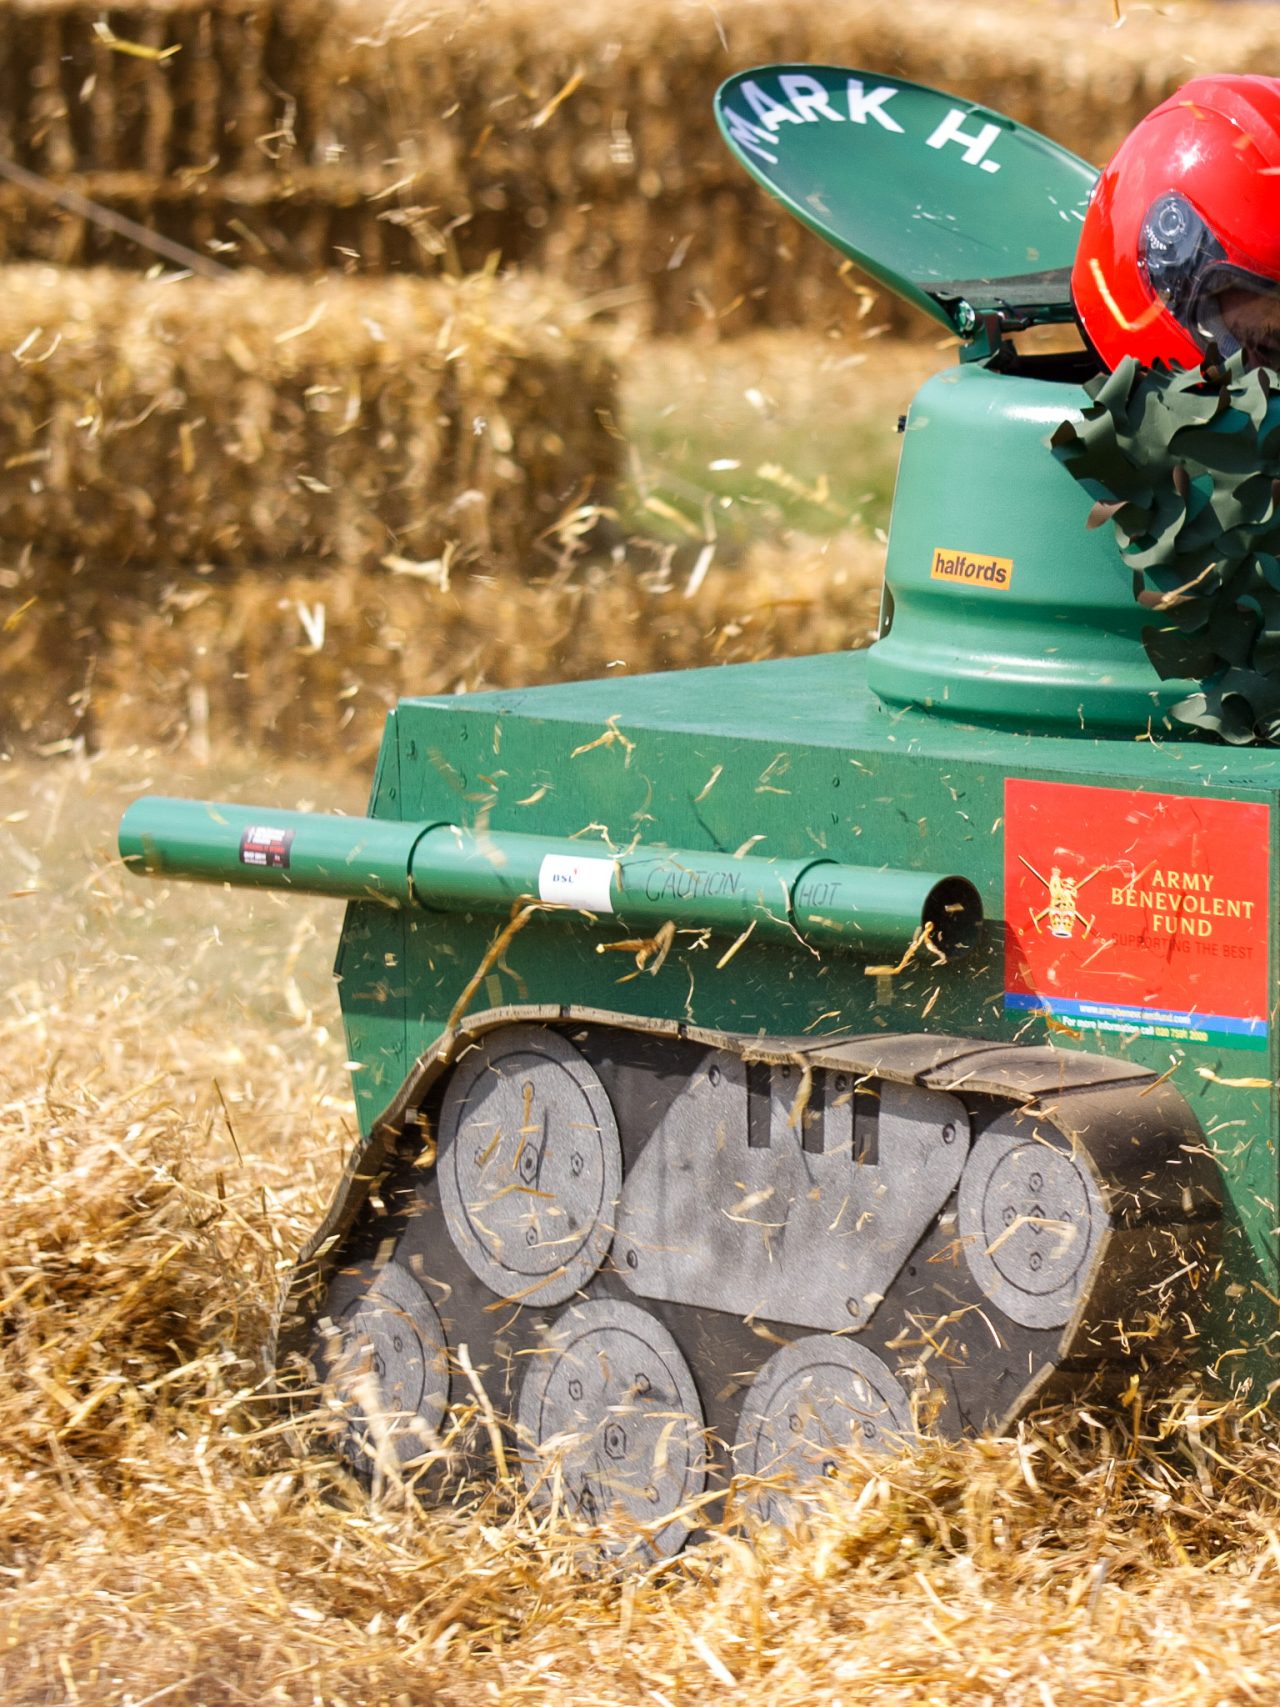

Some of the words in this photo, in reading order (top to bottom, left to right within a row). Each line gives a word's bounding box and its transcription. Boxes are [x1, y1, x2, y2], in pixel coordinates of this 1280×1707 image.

[723, 74, 905, 165] MARK
[926, 109, 1002, 174] H.
[935, 552, 1007, 584] halfords
[645, 866, 743, 902] CAUTION
[798, 882, 843, 908] HOT
[1151, 869, 1215, 893] ARMY
[1111, 887, 1255, 920] BENEVOLENT
[1152, 914, 1213, 938] FUND
[1111, 932, 1192, 955] SUPPORTING
[1196, 941, 1220, 957] THE
[1223, 944, 1255, 961] BEST
